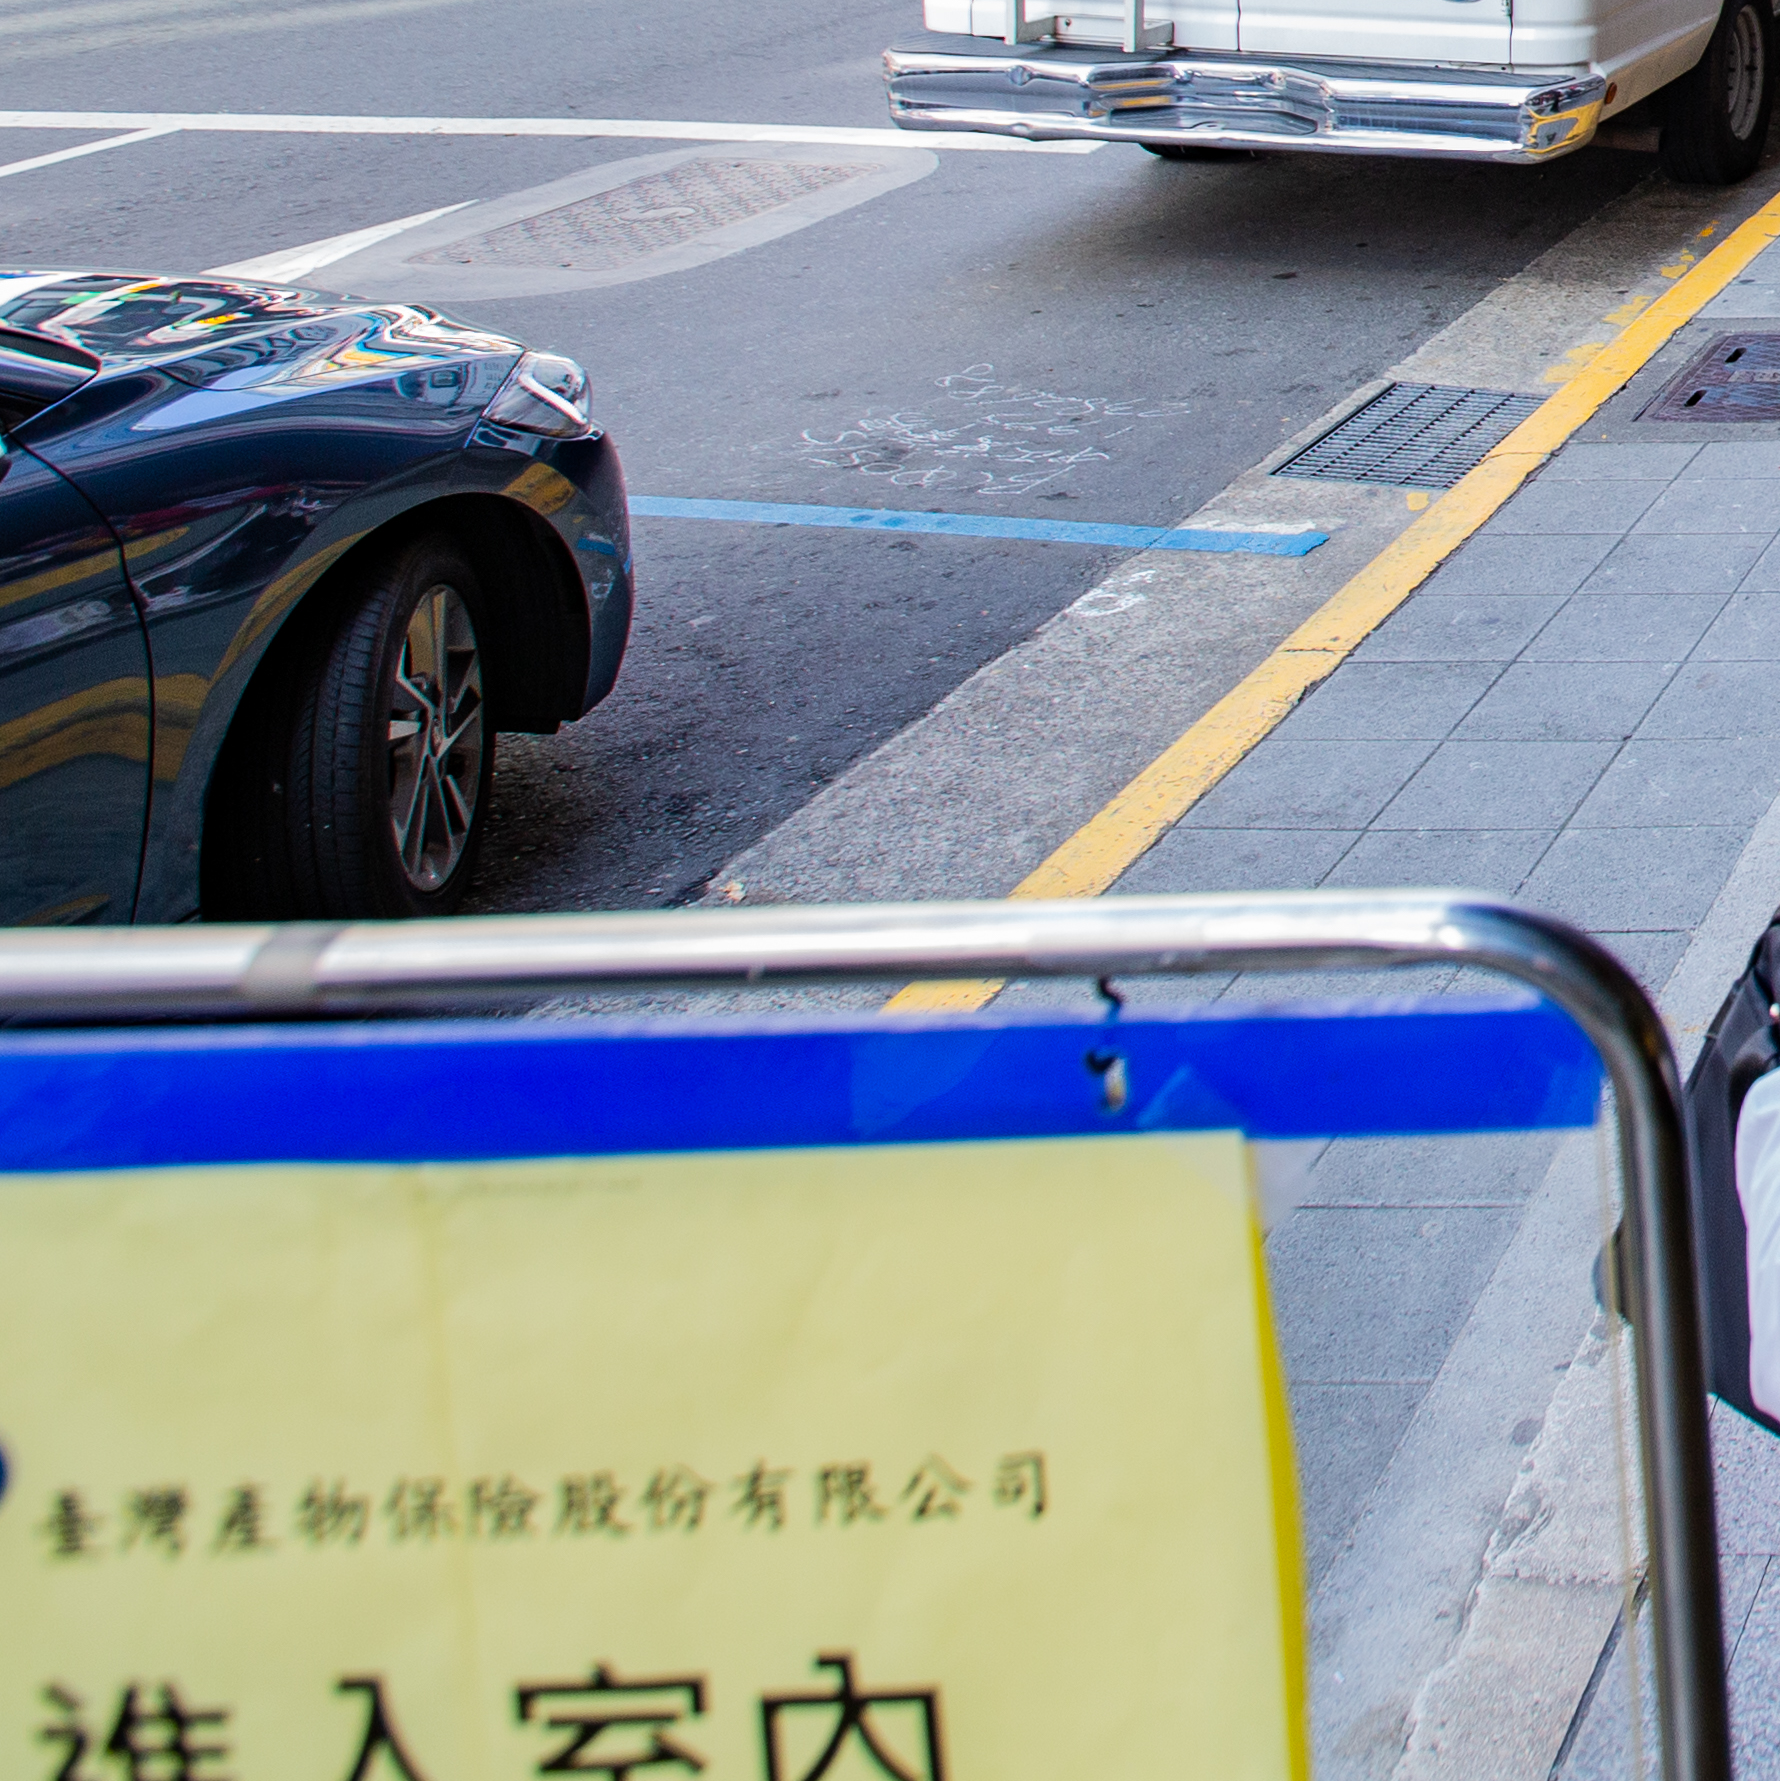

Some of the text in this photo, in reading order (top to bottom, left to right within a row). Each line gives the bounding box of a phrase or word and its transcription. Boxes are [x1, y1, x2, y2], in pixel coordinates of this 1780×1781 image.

[36, 1450, 1053, 1562] 臺灣產物保險股份有限公司
